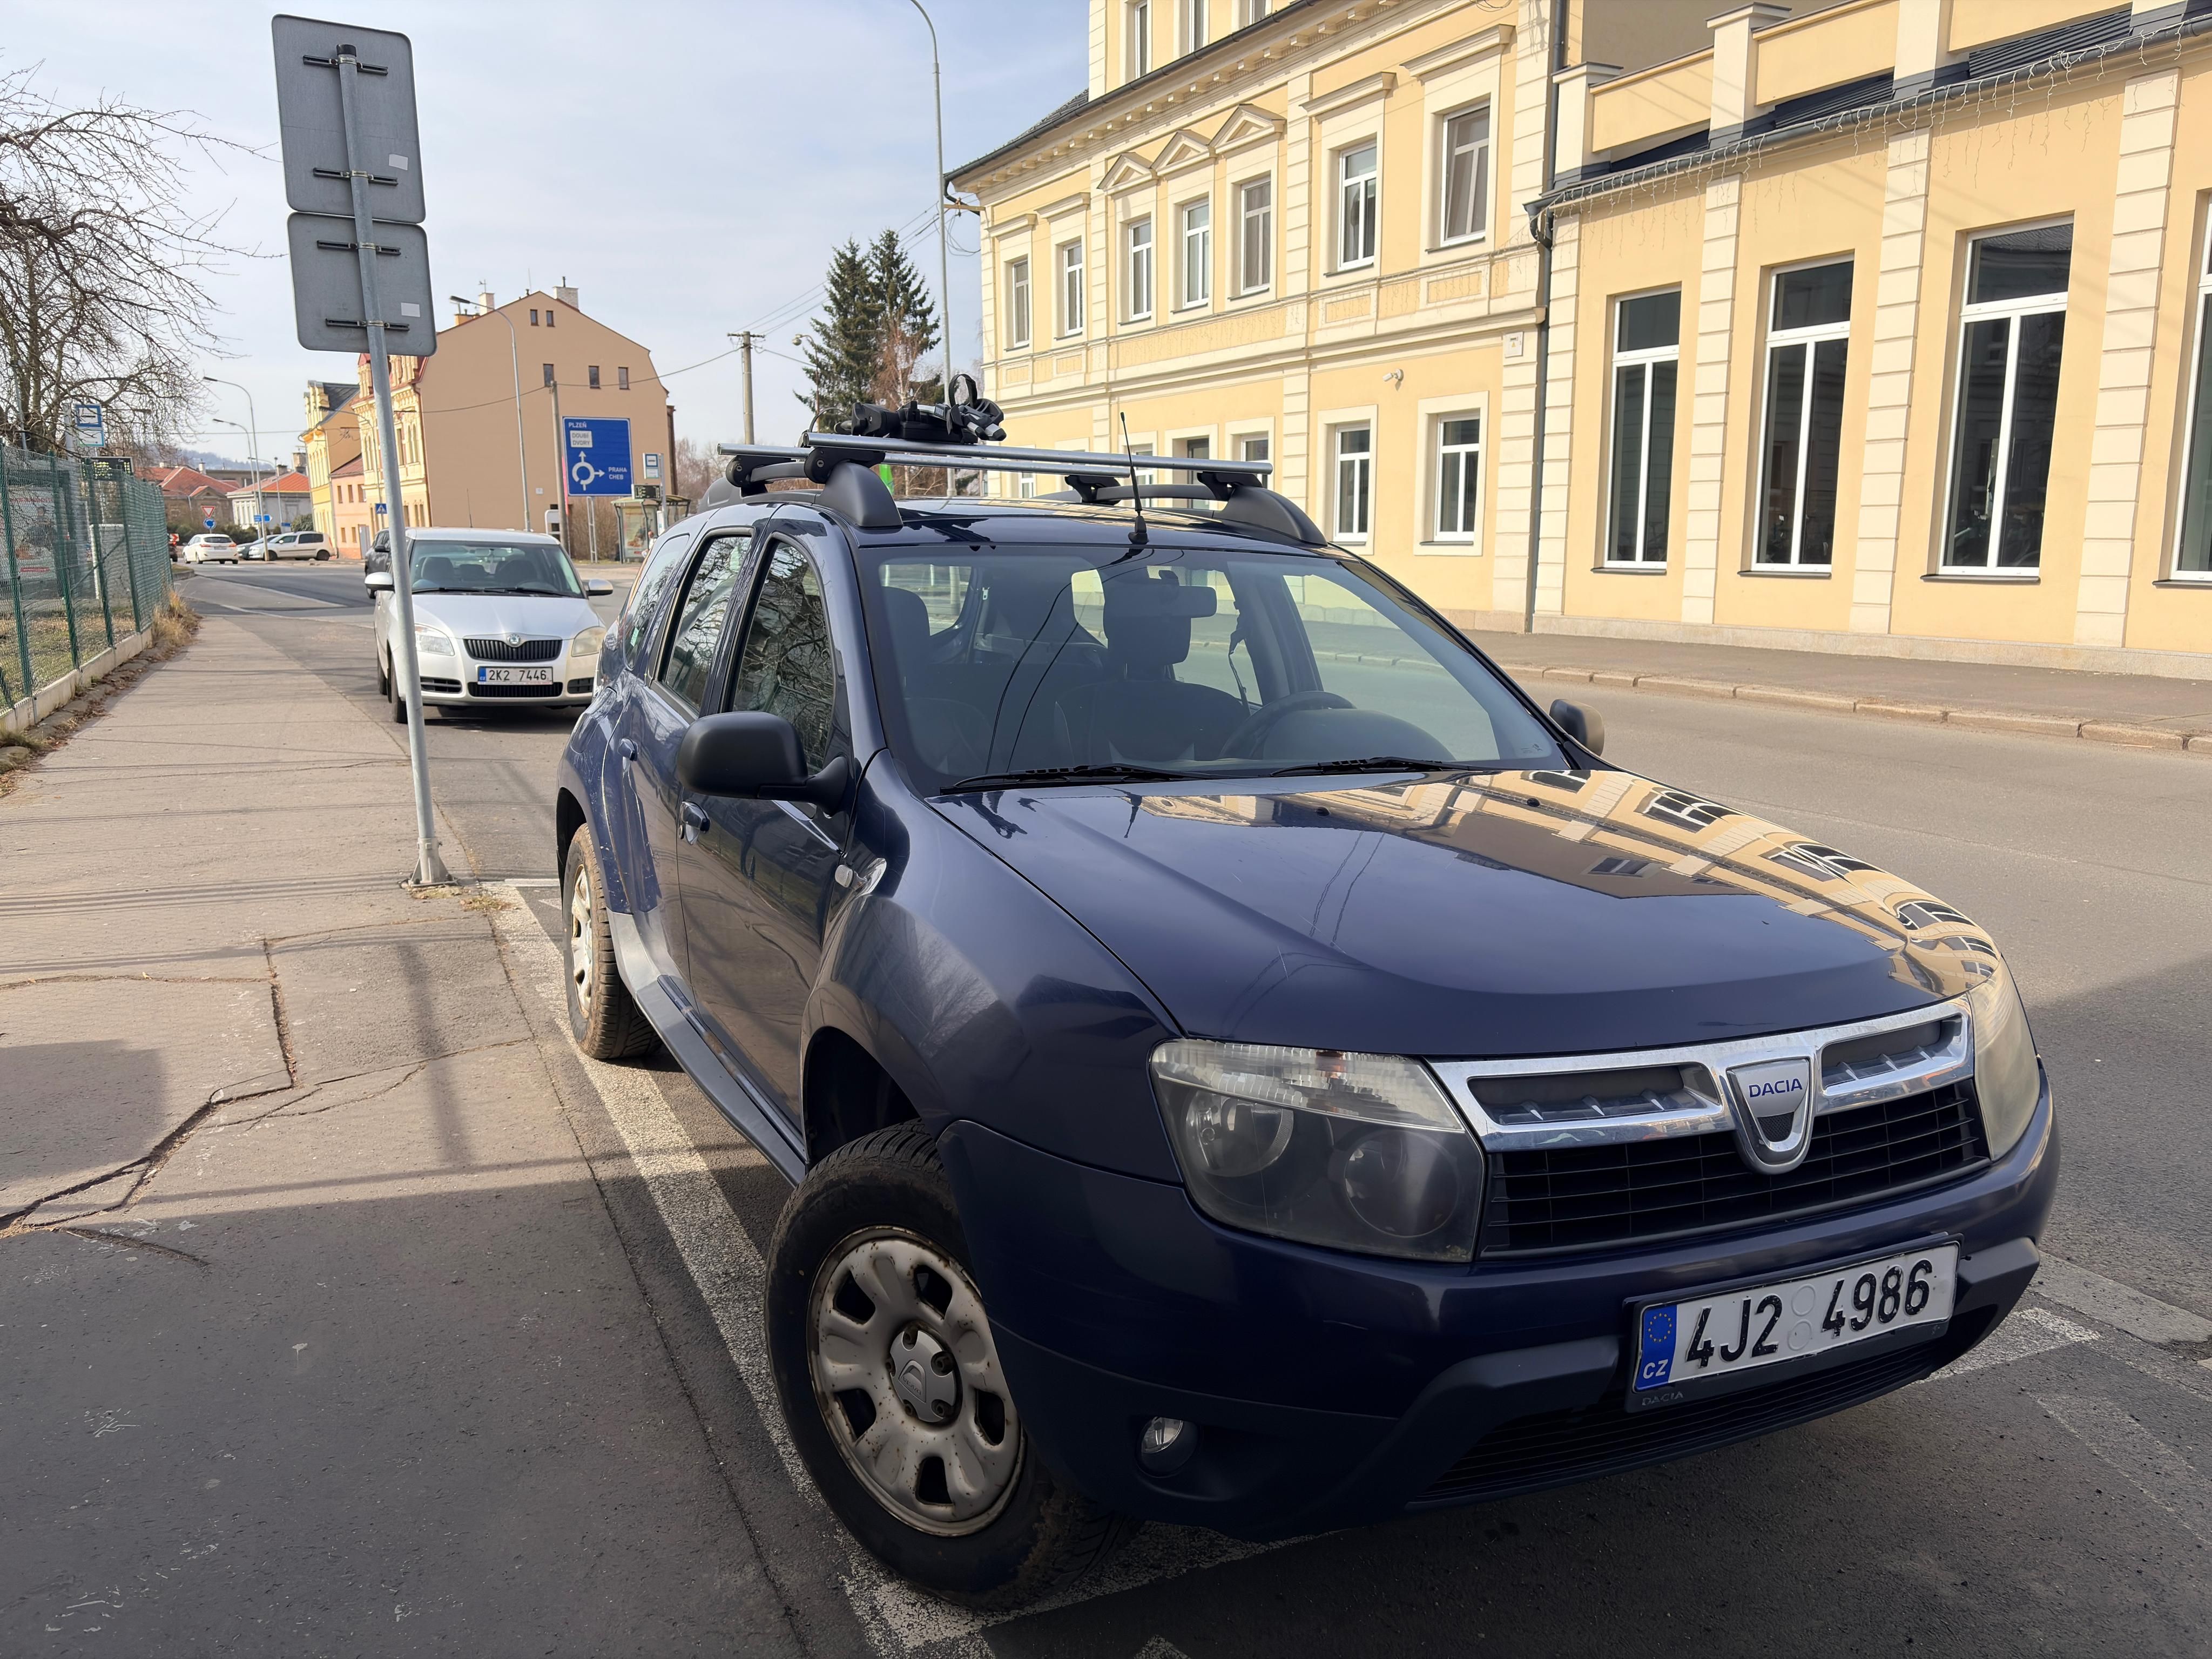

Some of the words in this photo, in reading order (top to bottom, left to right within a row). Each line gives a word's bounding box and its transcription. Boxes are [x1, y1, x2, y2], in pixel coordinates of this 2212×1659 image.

[489, 670, 510, 681] 2K2
[519, 670, 547, 682] 7446
[1748, 1078, 1803, 1098] DACIA
[1685, 1294, 1783, 1369] 4J2
[1820, 1258, 1933, 1339] 4986
[1642, 1358, 1669, 1380] CZ
[1642, 1391, 1684, 1406] DACIA
